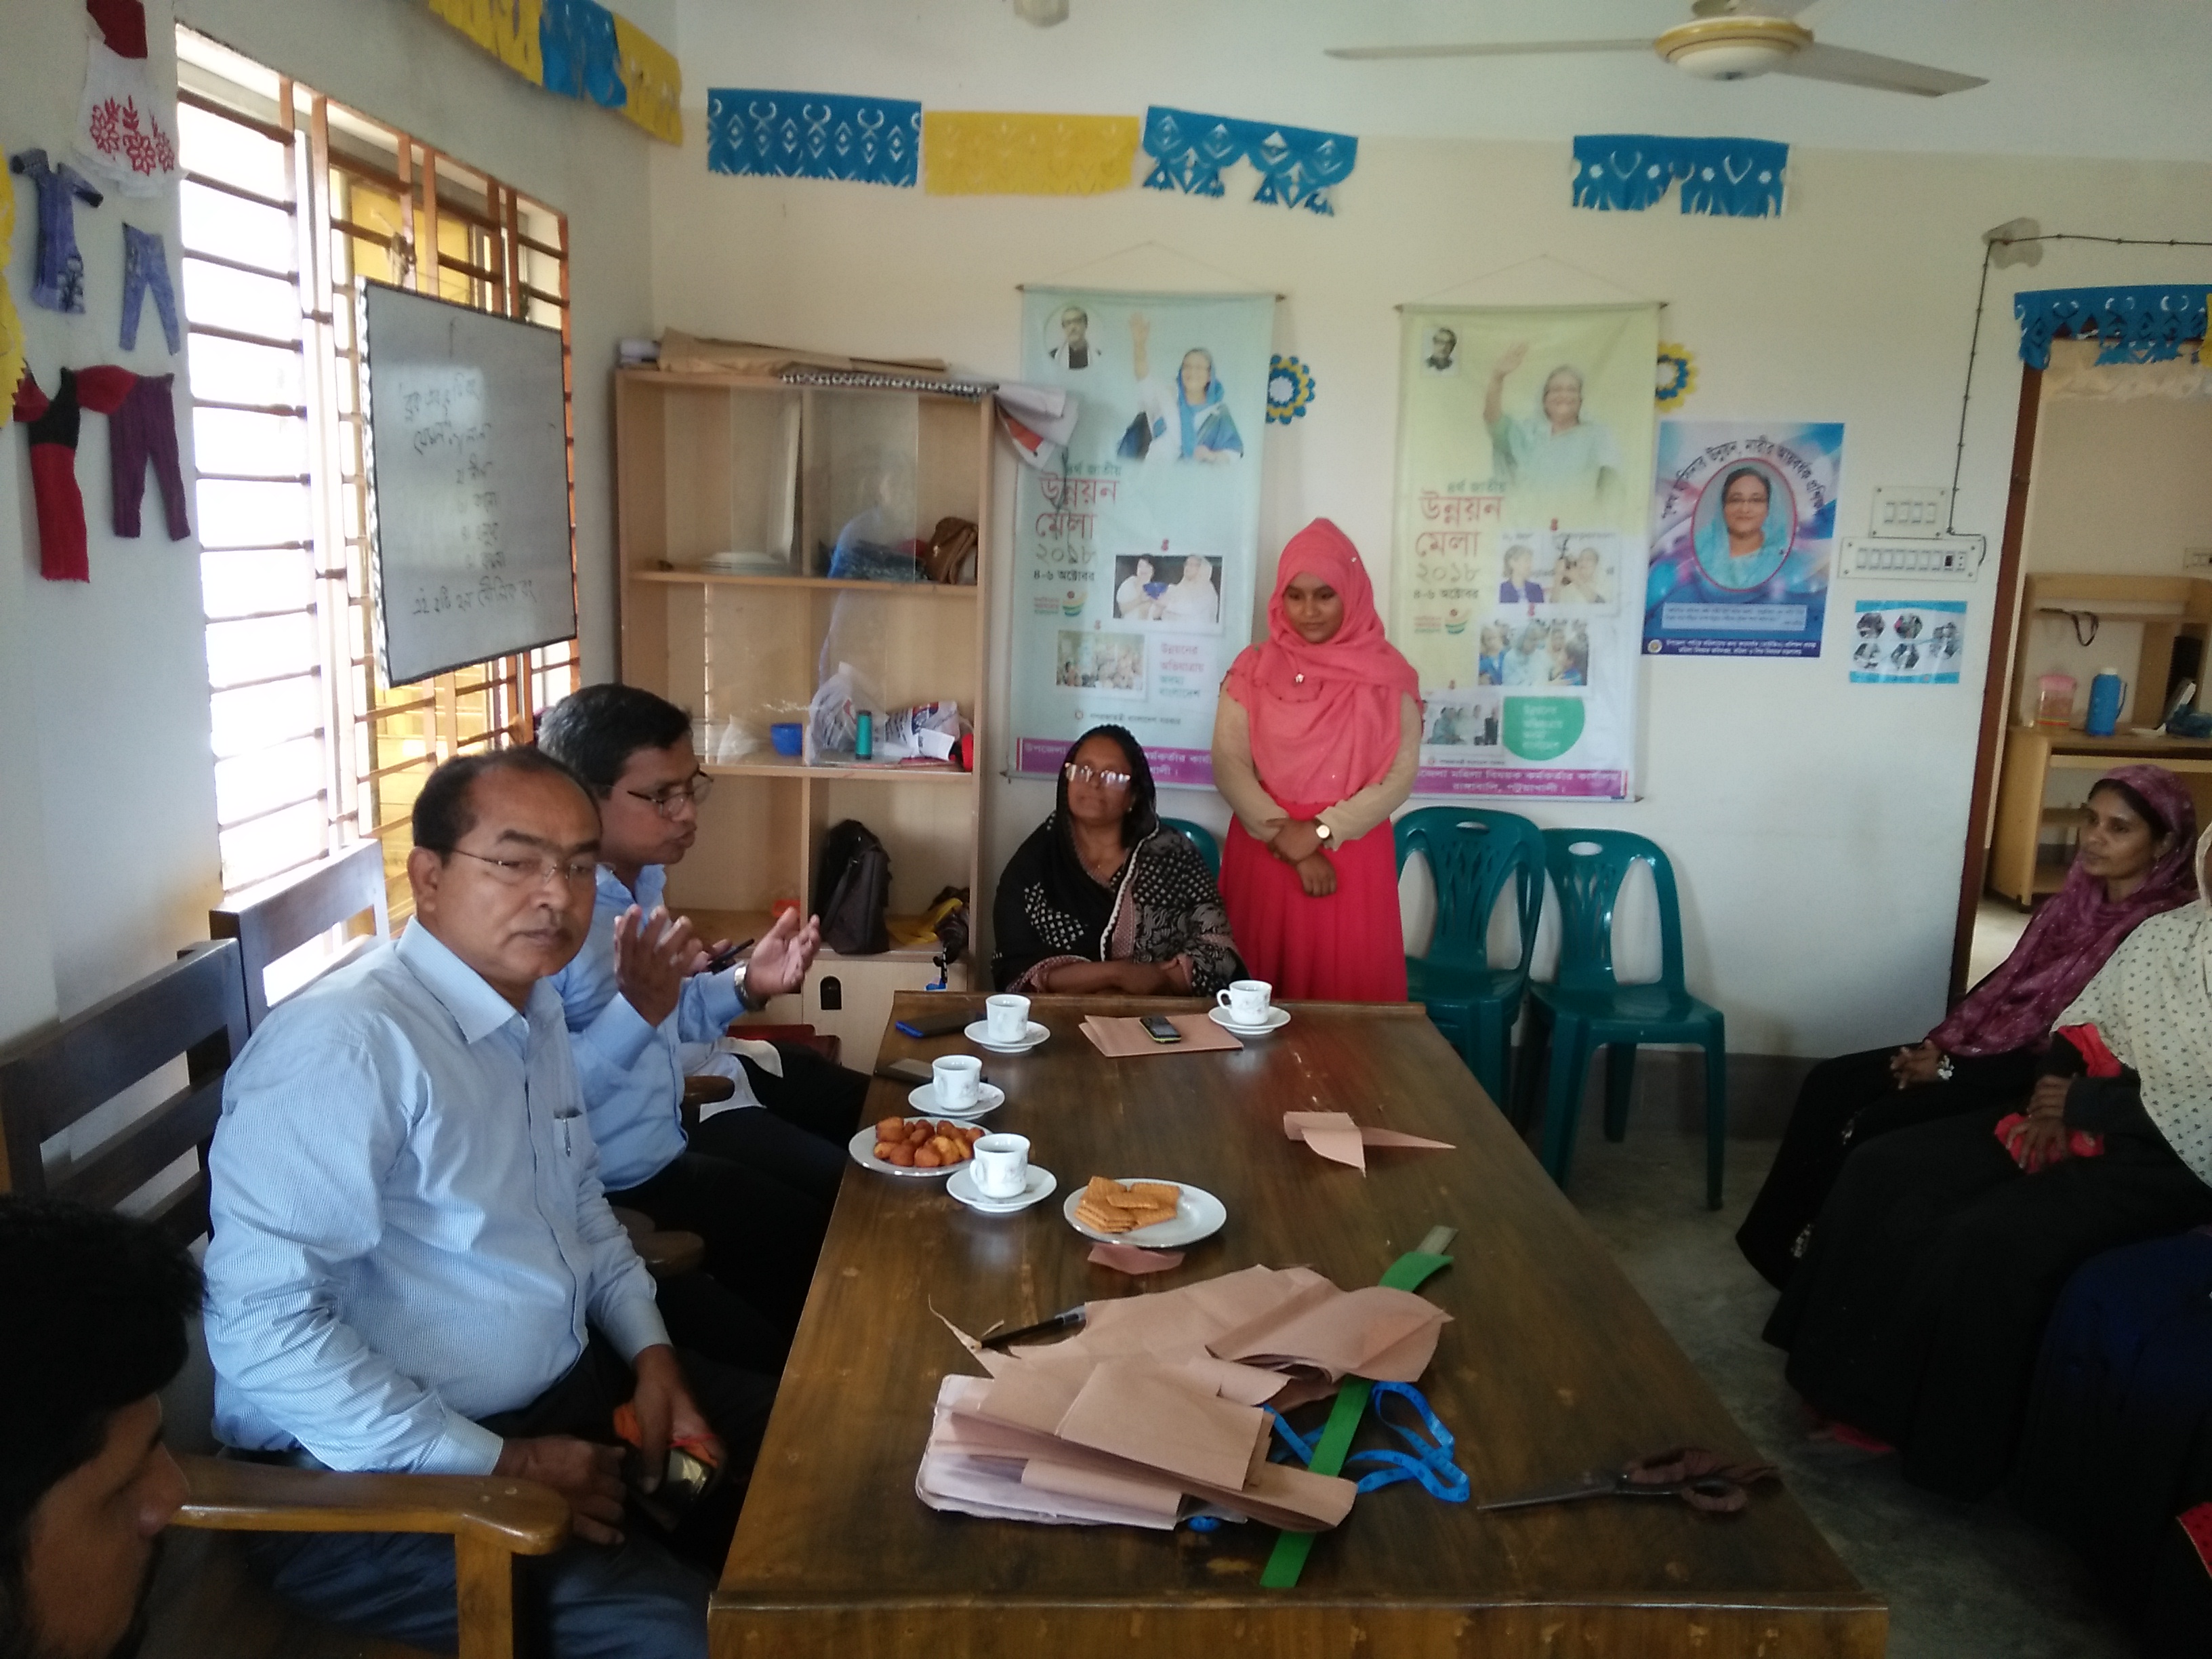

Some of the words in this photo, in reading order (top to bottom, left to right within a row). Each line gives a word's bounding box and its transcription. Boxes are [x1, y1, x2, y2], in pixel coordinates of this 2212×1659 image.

[1038, 472, 1120, 509] উন্নয়ন
[1419, 489, 1504, 527] উন্নয়ন
[1035, 512, 1098, 539] মেলা
[1036, 544, 1096, 565] ২০১৮
[1415, 531, 1482, 558] মেলা
[1058, 570, 1094, 582] অক্টোবর
[1416, 562, 1481, 584] ২০১৮
[1439, 588, 1479, 600] অক্টোবর
